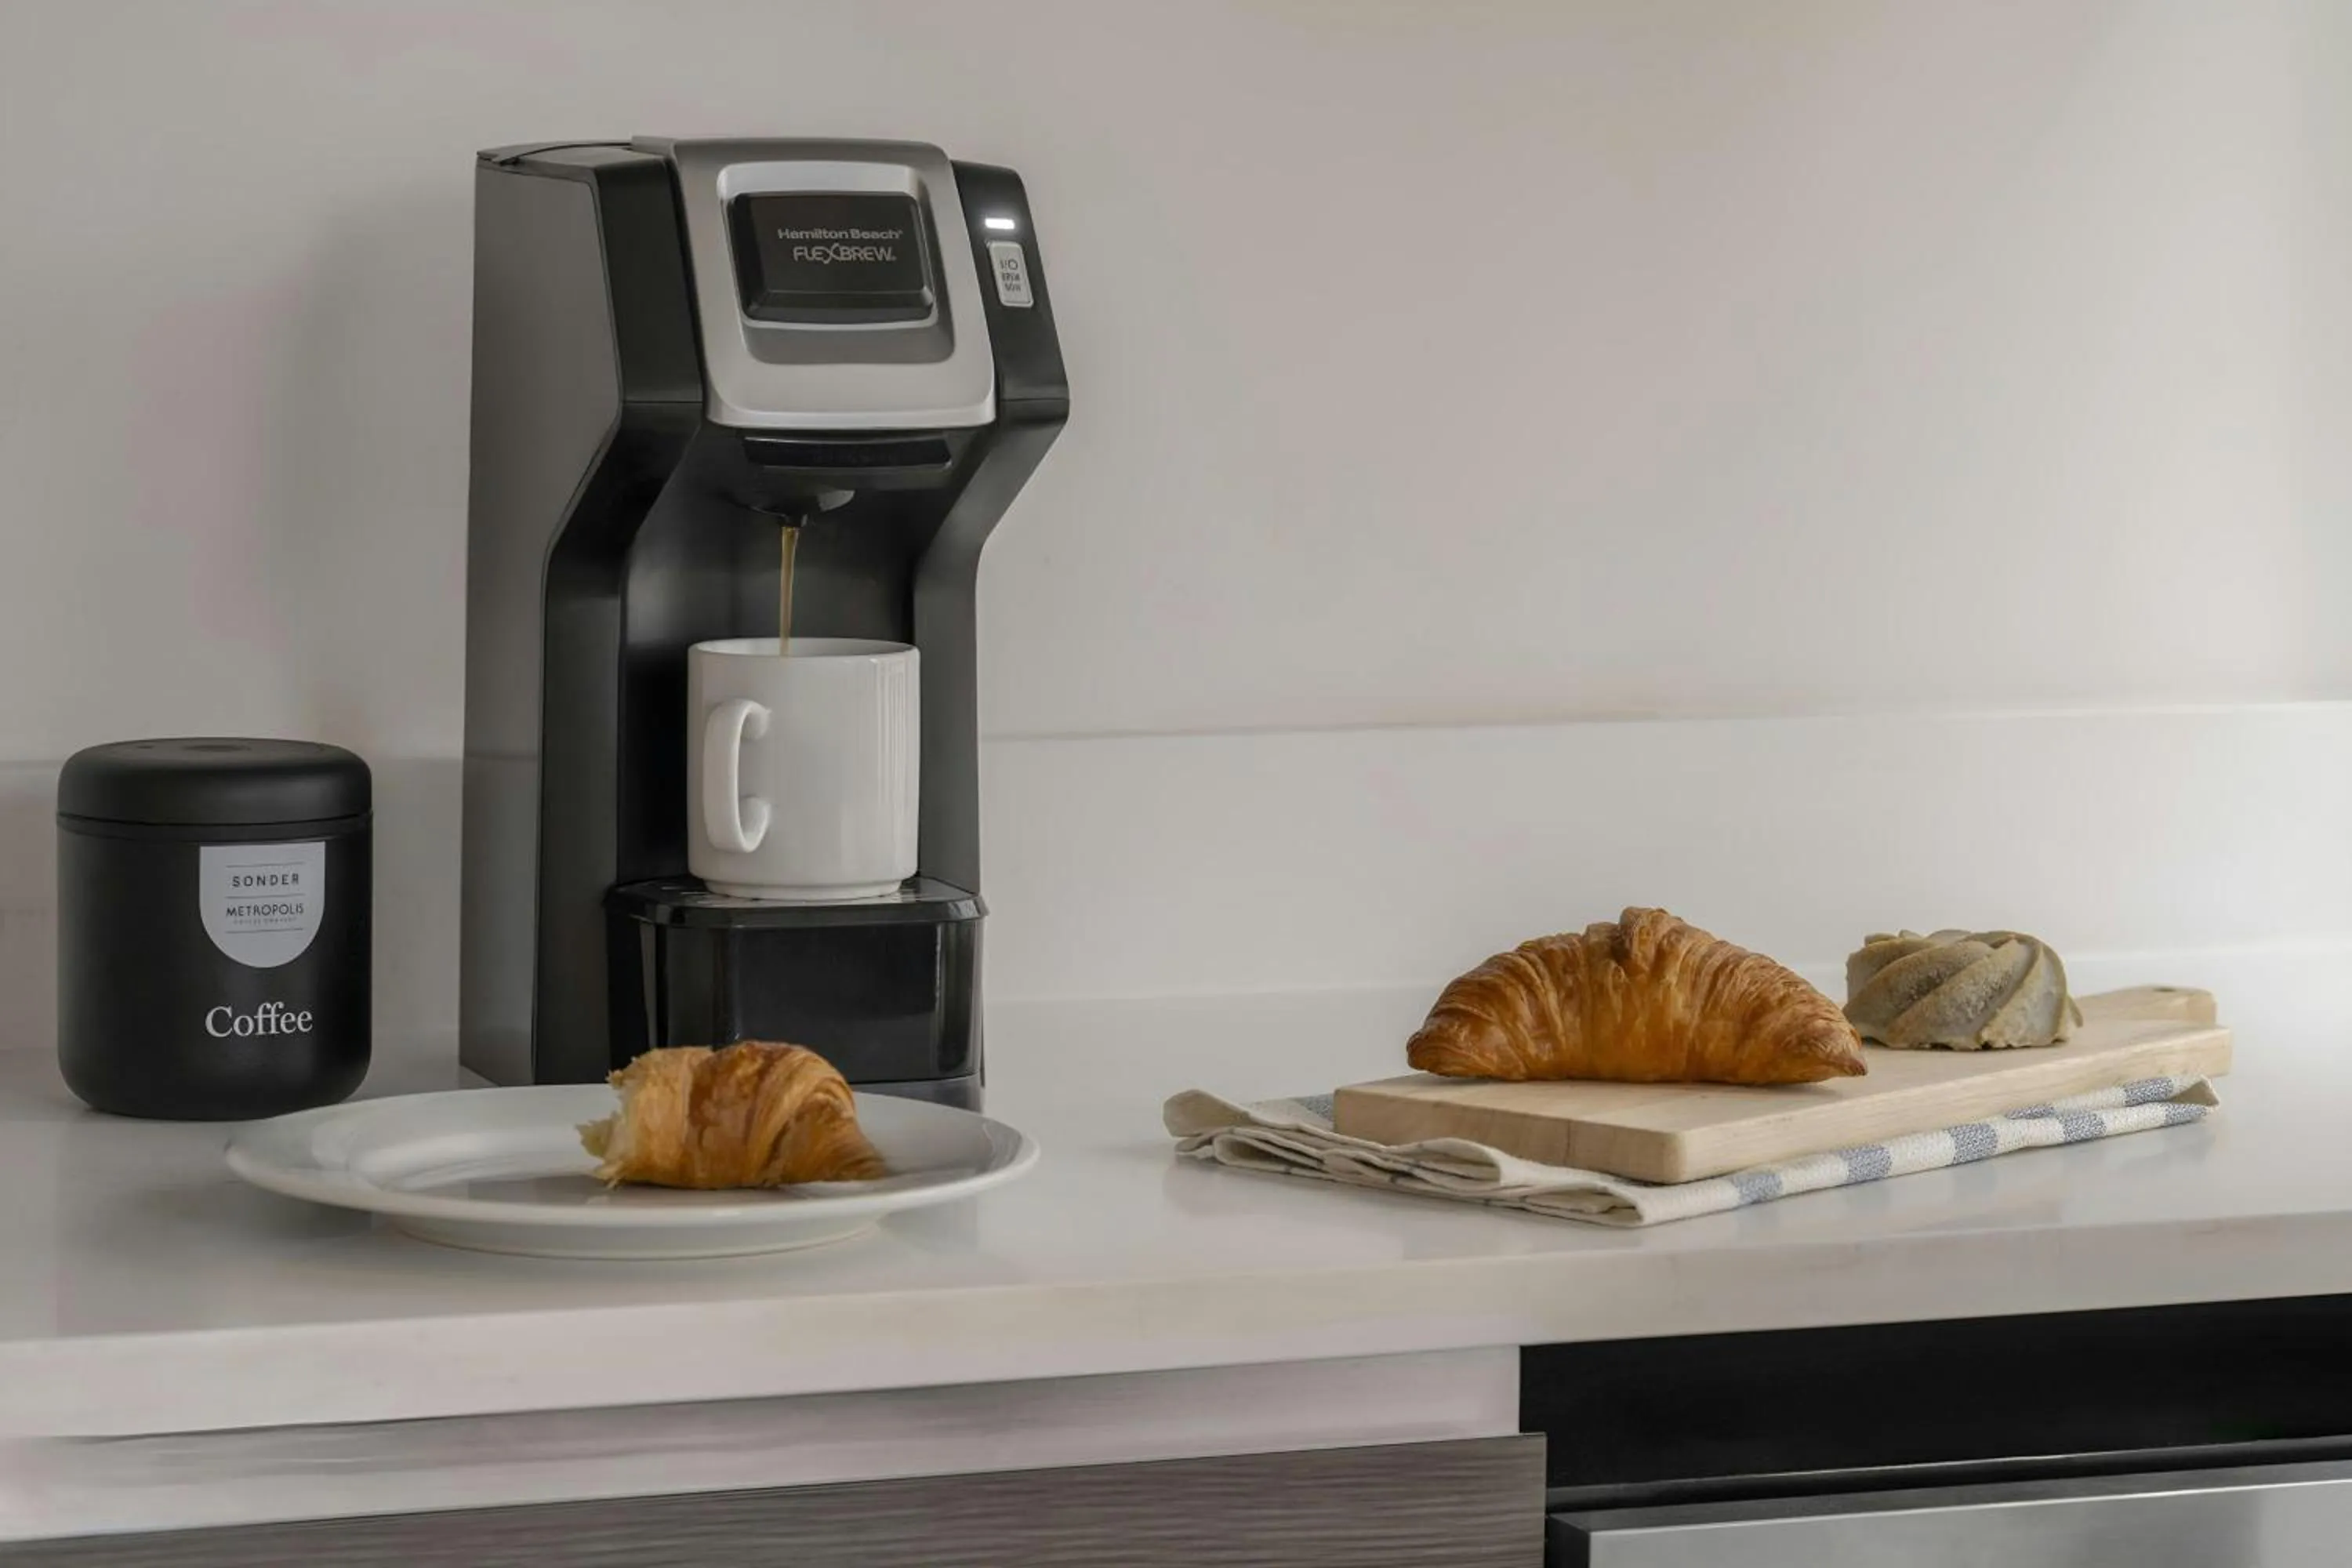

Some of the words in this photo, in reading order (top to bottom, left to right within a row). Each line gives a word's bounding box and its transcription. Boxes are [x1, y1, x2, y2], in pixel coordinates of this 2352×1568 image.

[777, 227, 848, 239] Hamilton
[232, 873, 299, 887] SONDER
[226, 903, 304, 916] METROPOLIS
[205, 1001, 313, 1037] Coffee
